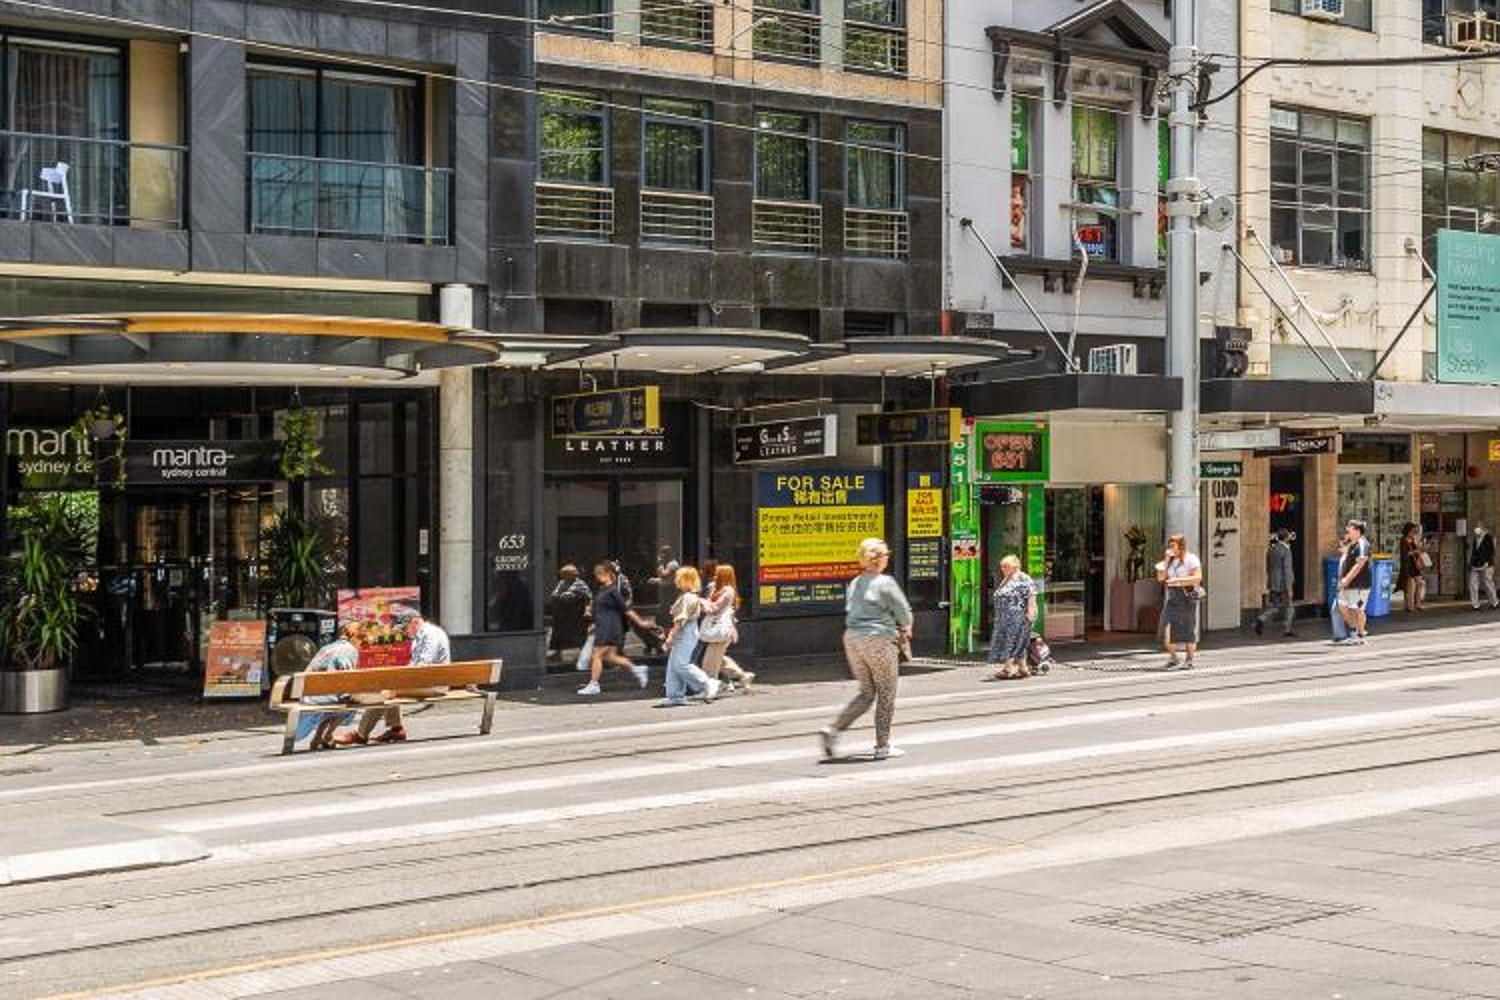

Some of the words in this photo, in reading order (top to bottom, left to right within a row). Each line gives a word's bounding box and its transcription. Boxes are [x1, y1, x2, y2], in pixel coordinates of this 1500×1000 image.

[6, 428, 93, 456] mant
[565, 441, 664, 451] LEATHER
[153, 446, 235, 467] mantra
[17, 459, 71, 475] sydney
[75, 460, 93, 474] ce
[161, 468, 194, 479] sydney
[777, 476, 814, 491] FOR
[820, 475, 865, 490] SALE
[499, 535, 526, 549] 653
